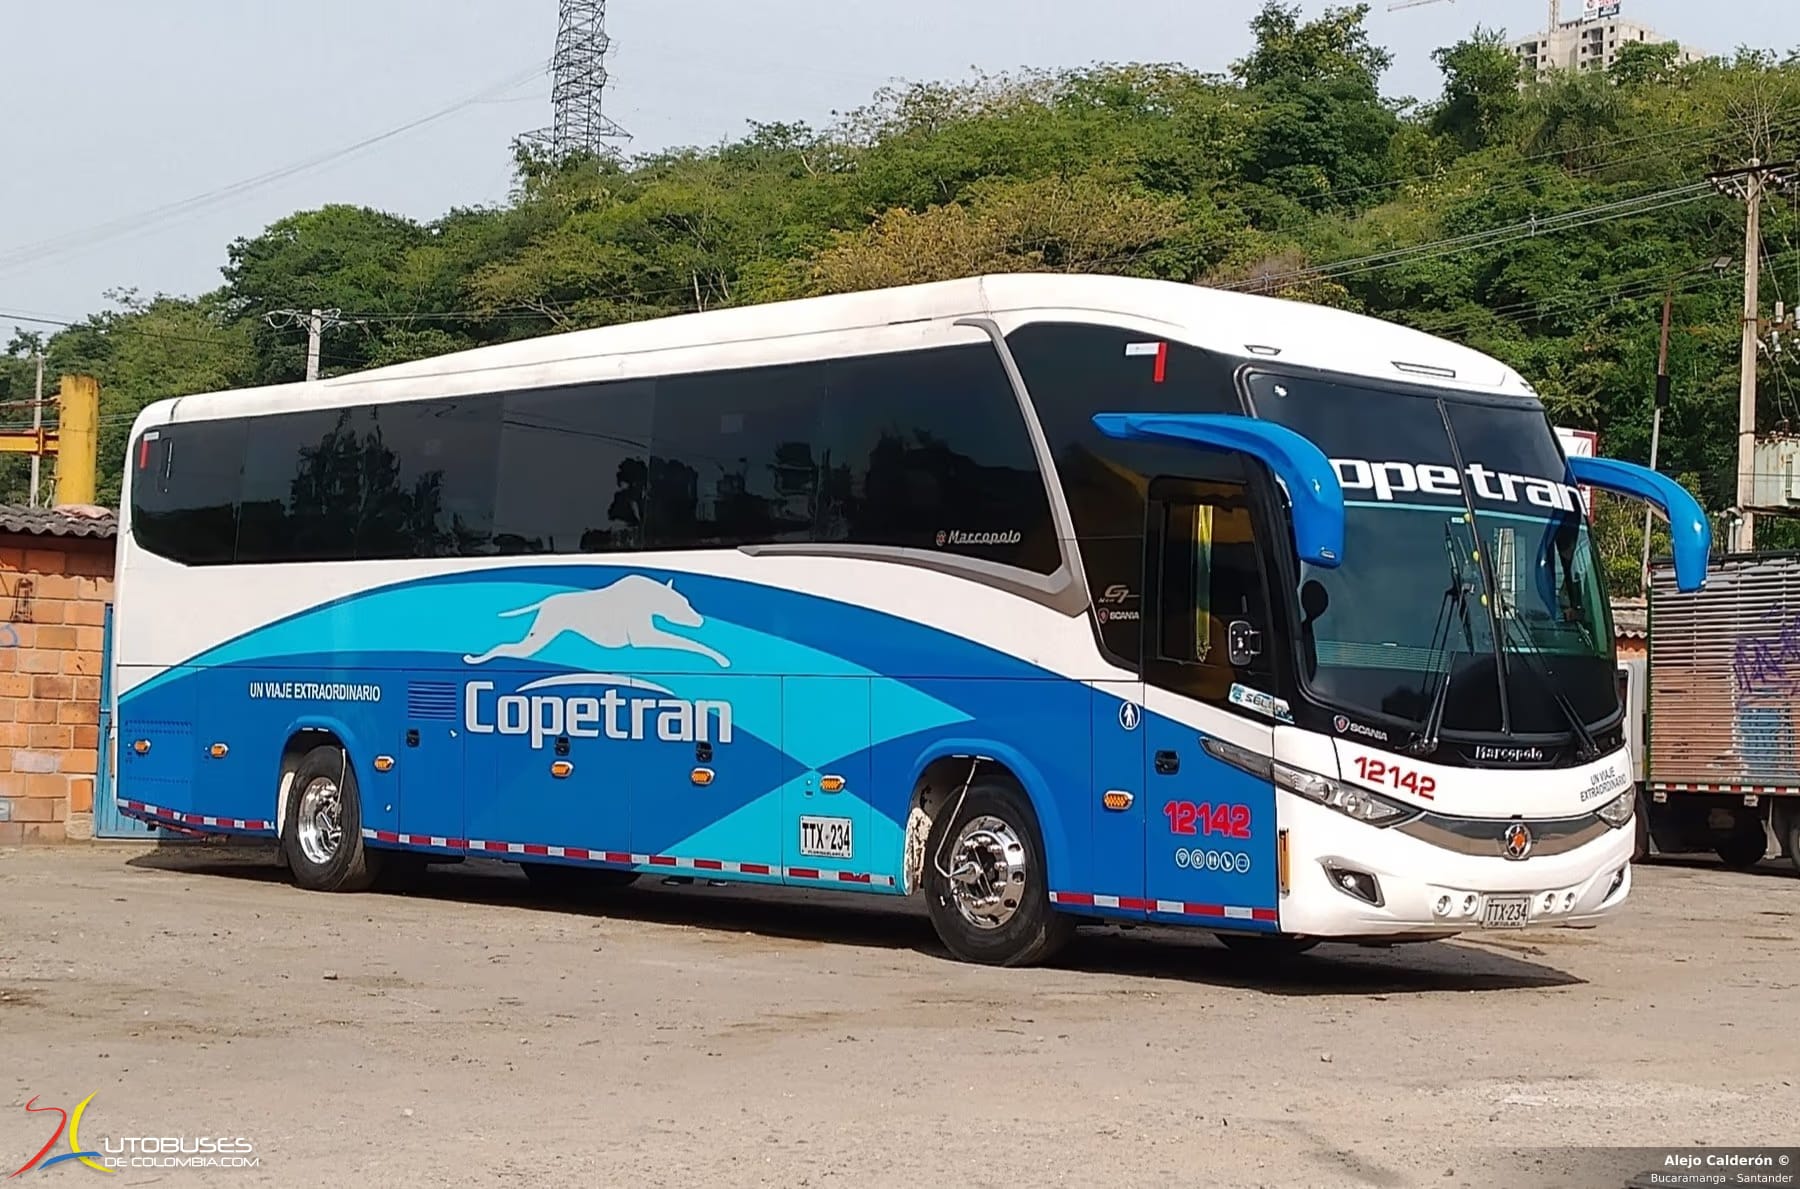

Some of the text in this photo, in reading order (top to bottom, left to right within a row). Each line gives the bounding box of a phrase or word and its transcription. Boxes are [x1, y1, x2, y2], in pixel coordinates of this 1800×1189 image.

[947, 529, 1022, 545] Marcopolo
[1109, 611, 1140, 620] SCANIA
[249, 682, 381, 702] UN VIAJE EXTRAORDINARIO
[465, 680, 733, 750] Copetran
[1350, 722, 1389, 741] SCANIA
[1354, 756, 1436, 800] 12142
[1163, 800, 1251, 840] 12142
